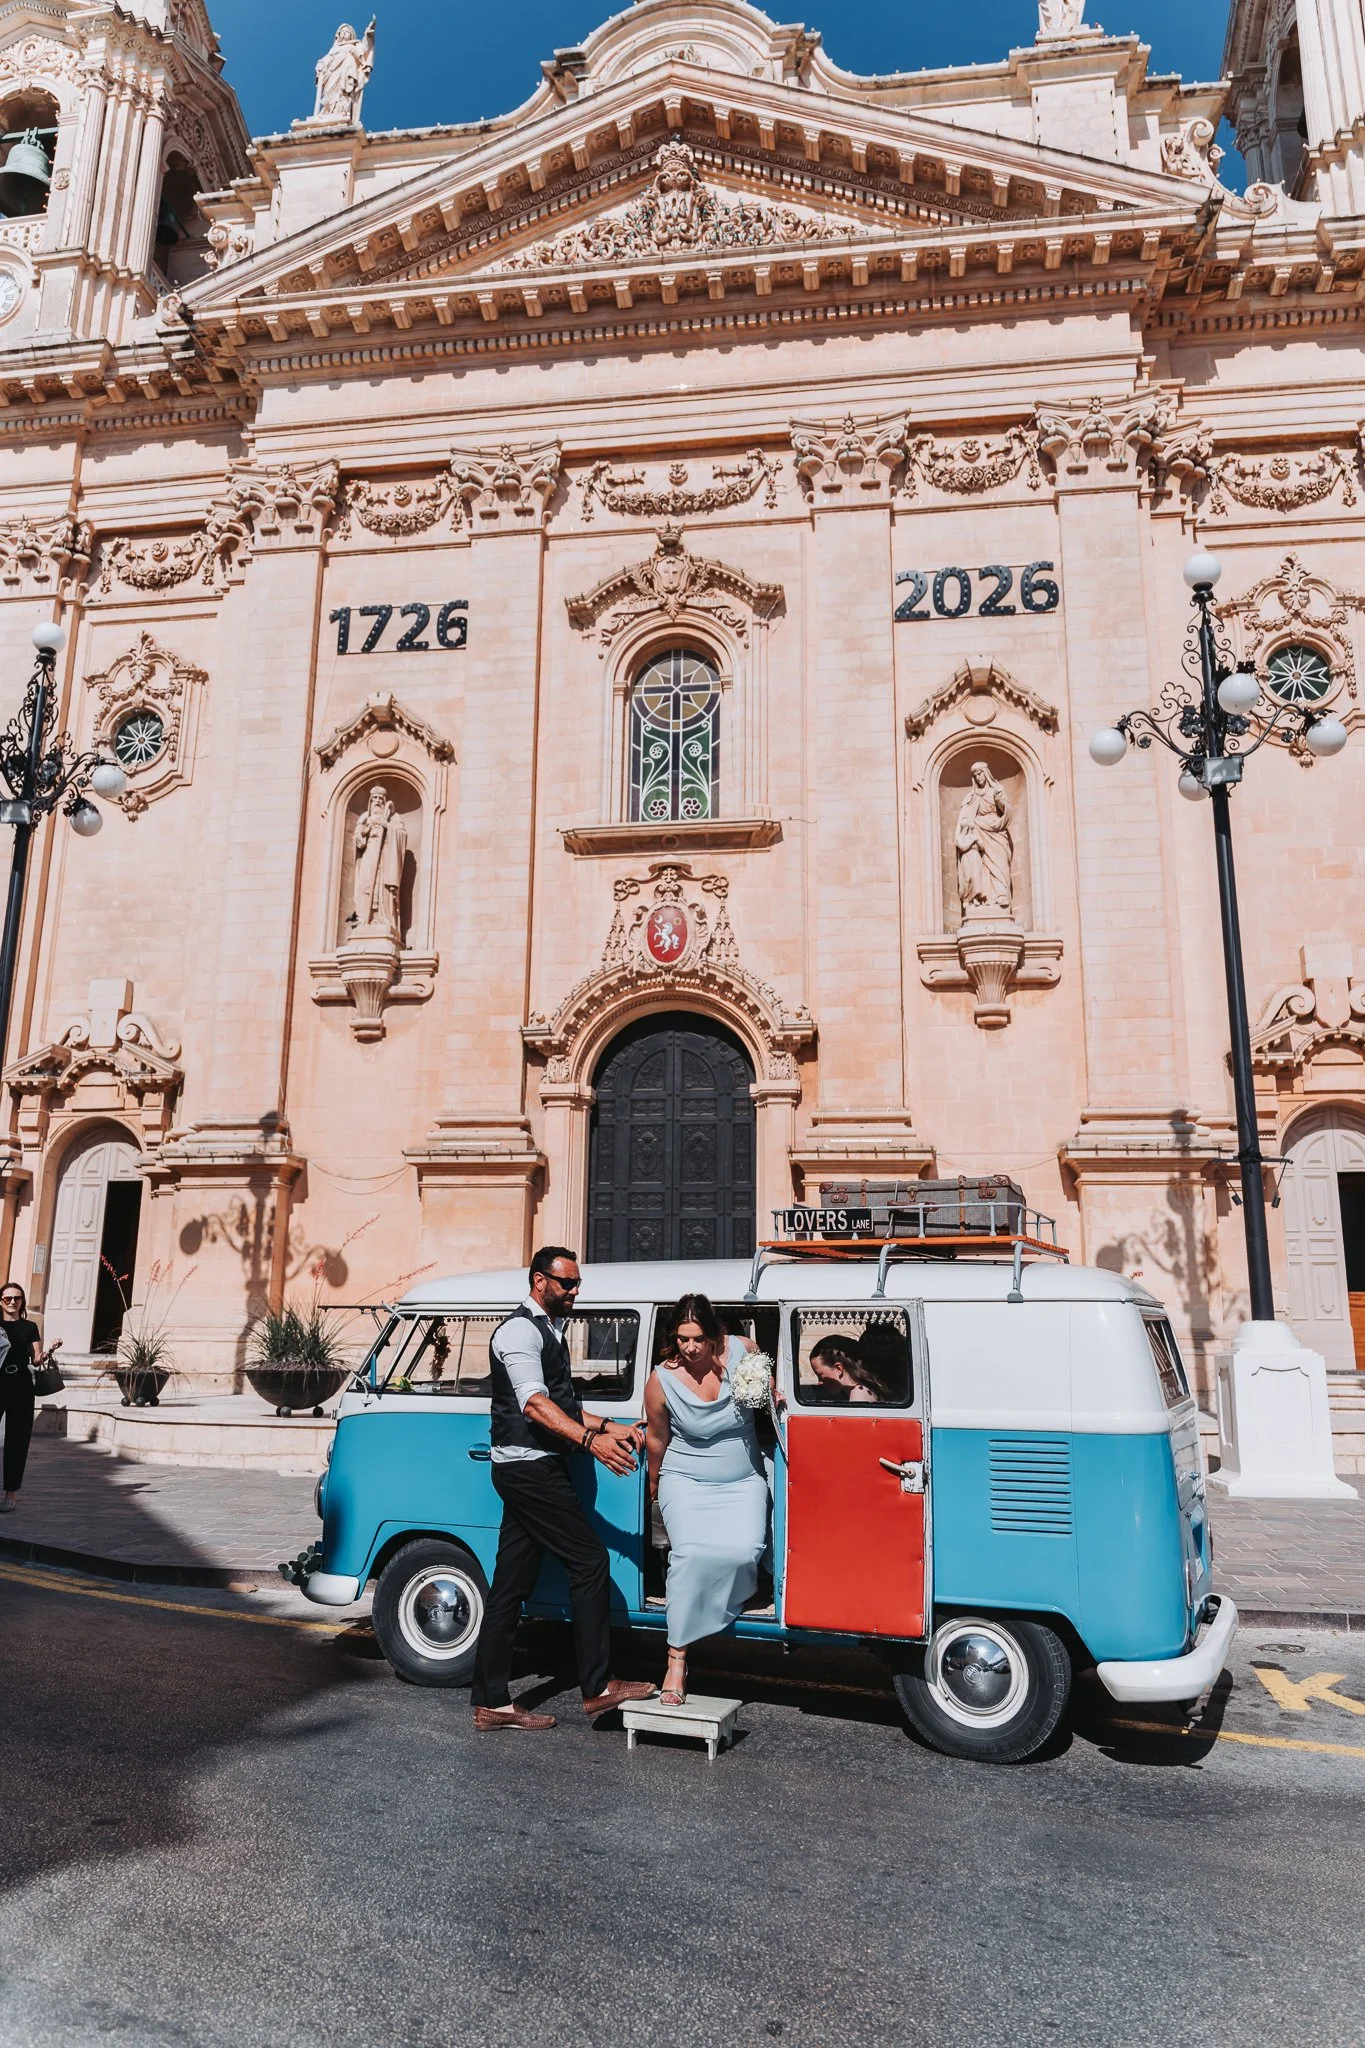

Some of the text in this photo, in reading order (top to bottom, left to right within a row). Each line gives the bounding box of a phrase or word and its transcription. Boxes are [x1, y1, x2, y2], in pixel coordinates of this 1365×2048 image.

[894, 561, 1060, 621] 2026
[329, 600, 469, 655] 1726
[785, 1210, 870, 1231] LOVERS LANE
